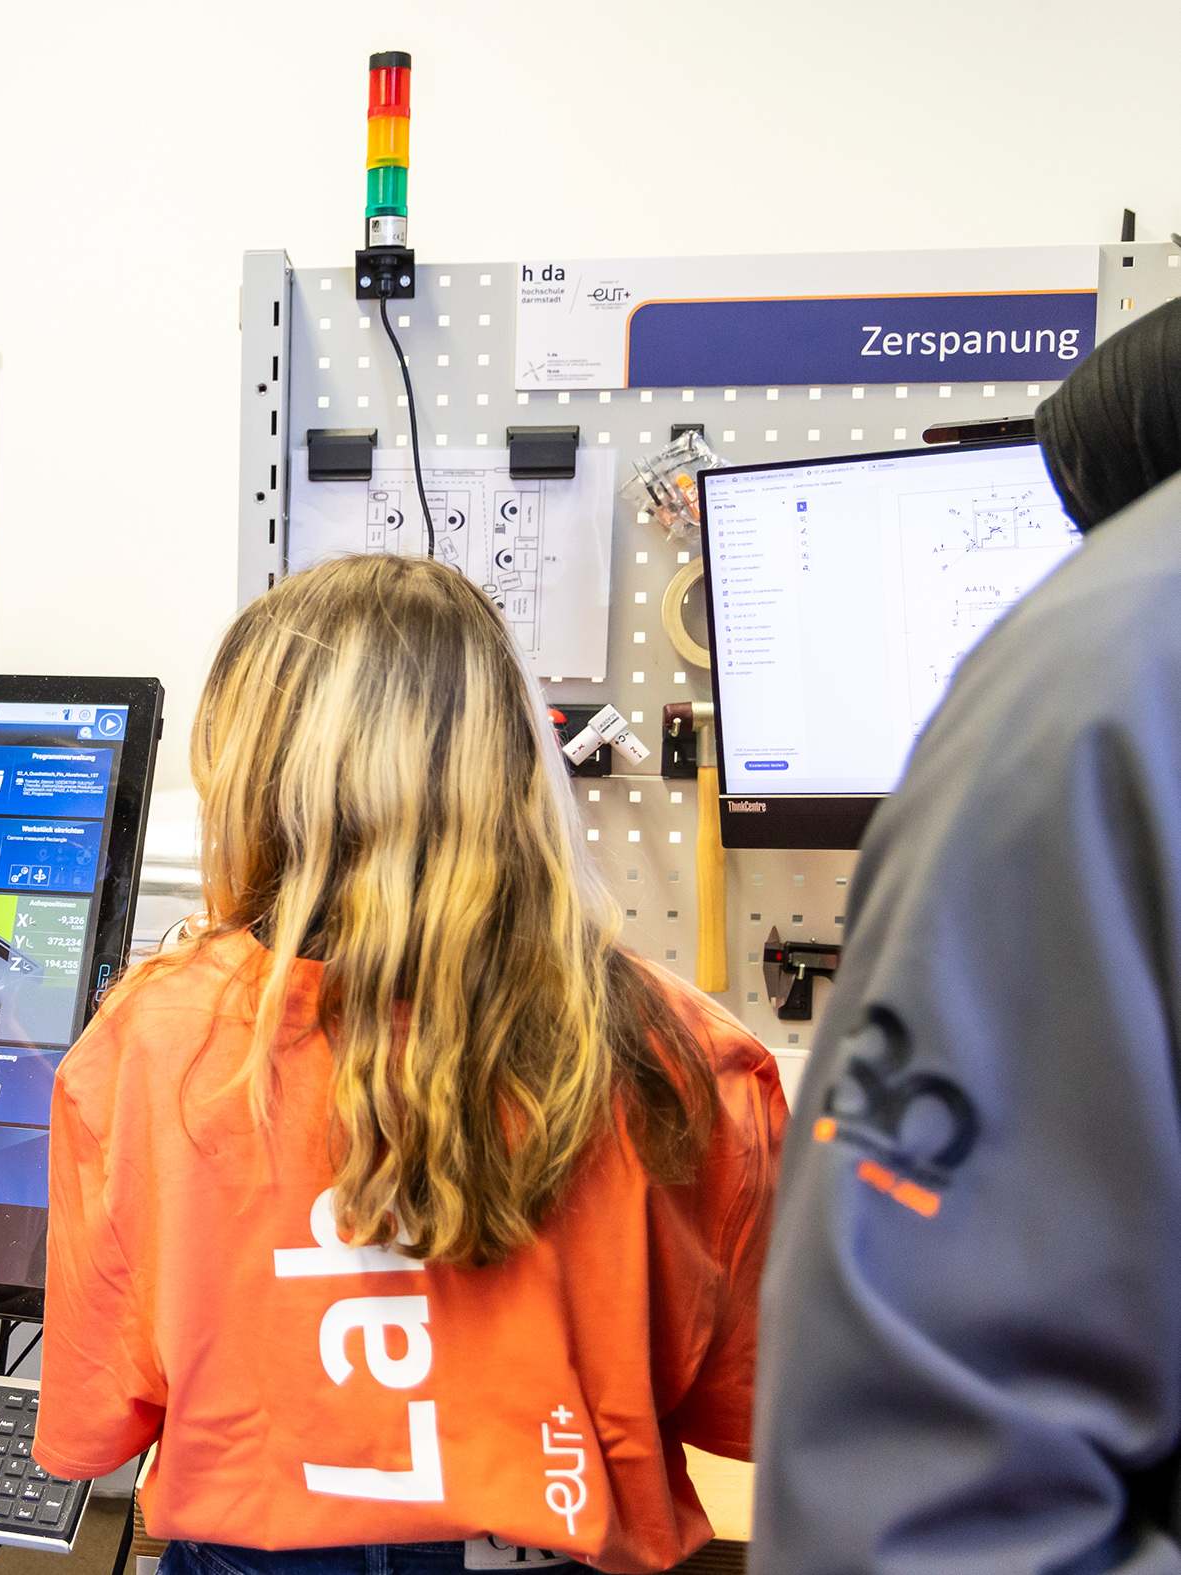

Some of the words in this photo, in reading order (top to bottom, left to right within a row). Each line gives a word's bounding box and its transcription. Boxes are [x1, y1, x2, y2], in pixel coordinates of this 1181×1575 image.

[522, 264, 565, 284] h_da
[521, 287, 565, 296] hochschule
[521, 295, 561, 304] darmstadt
[860, 326, 1080, 361] Zerspanung
[32, 753, 96, 762] Programmverwaltung
[727, 800, 767, 813] ThinkCentre
[21, 825, 53, 833] Werkstück
[29, 900, 76, 908] Achspositionen
[16, 913, 29, 927] X
[57, 916, 85, 925] -9,326
[14, 935, 26, 949] Y
[47, 937, 82, 947] 372,234
[9, 957, 22, 971] Z
[44, 959, 78, 969] 194,255
[274, 1186, 444, 1502] Lab
